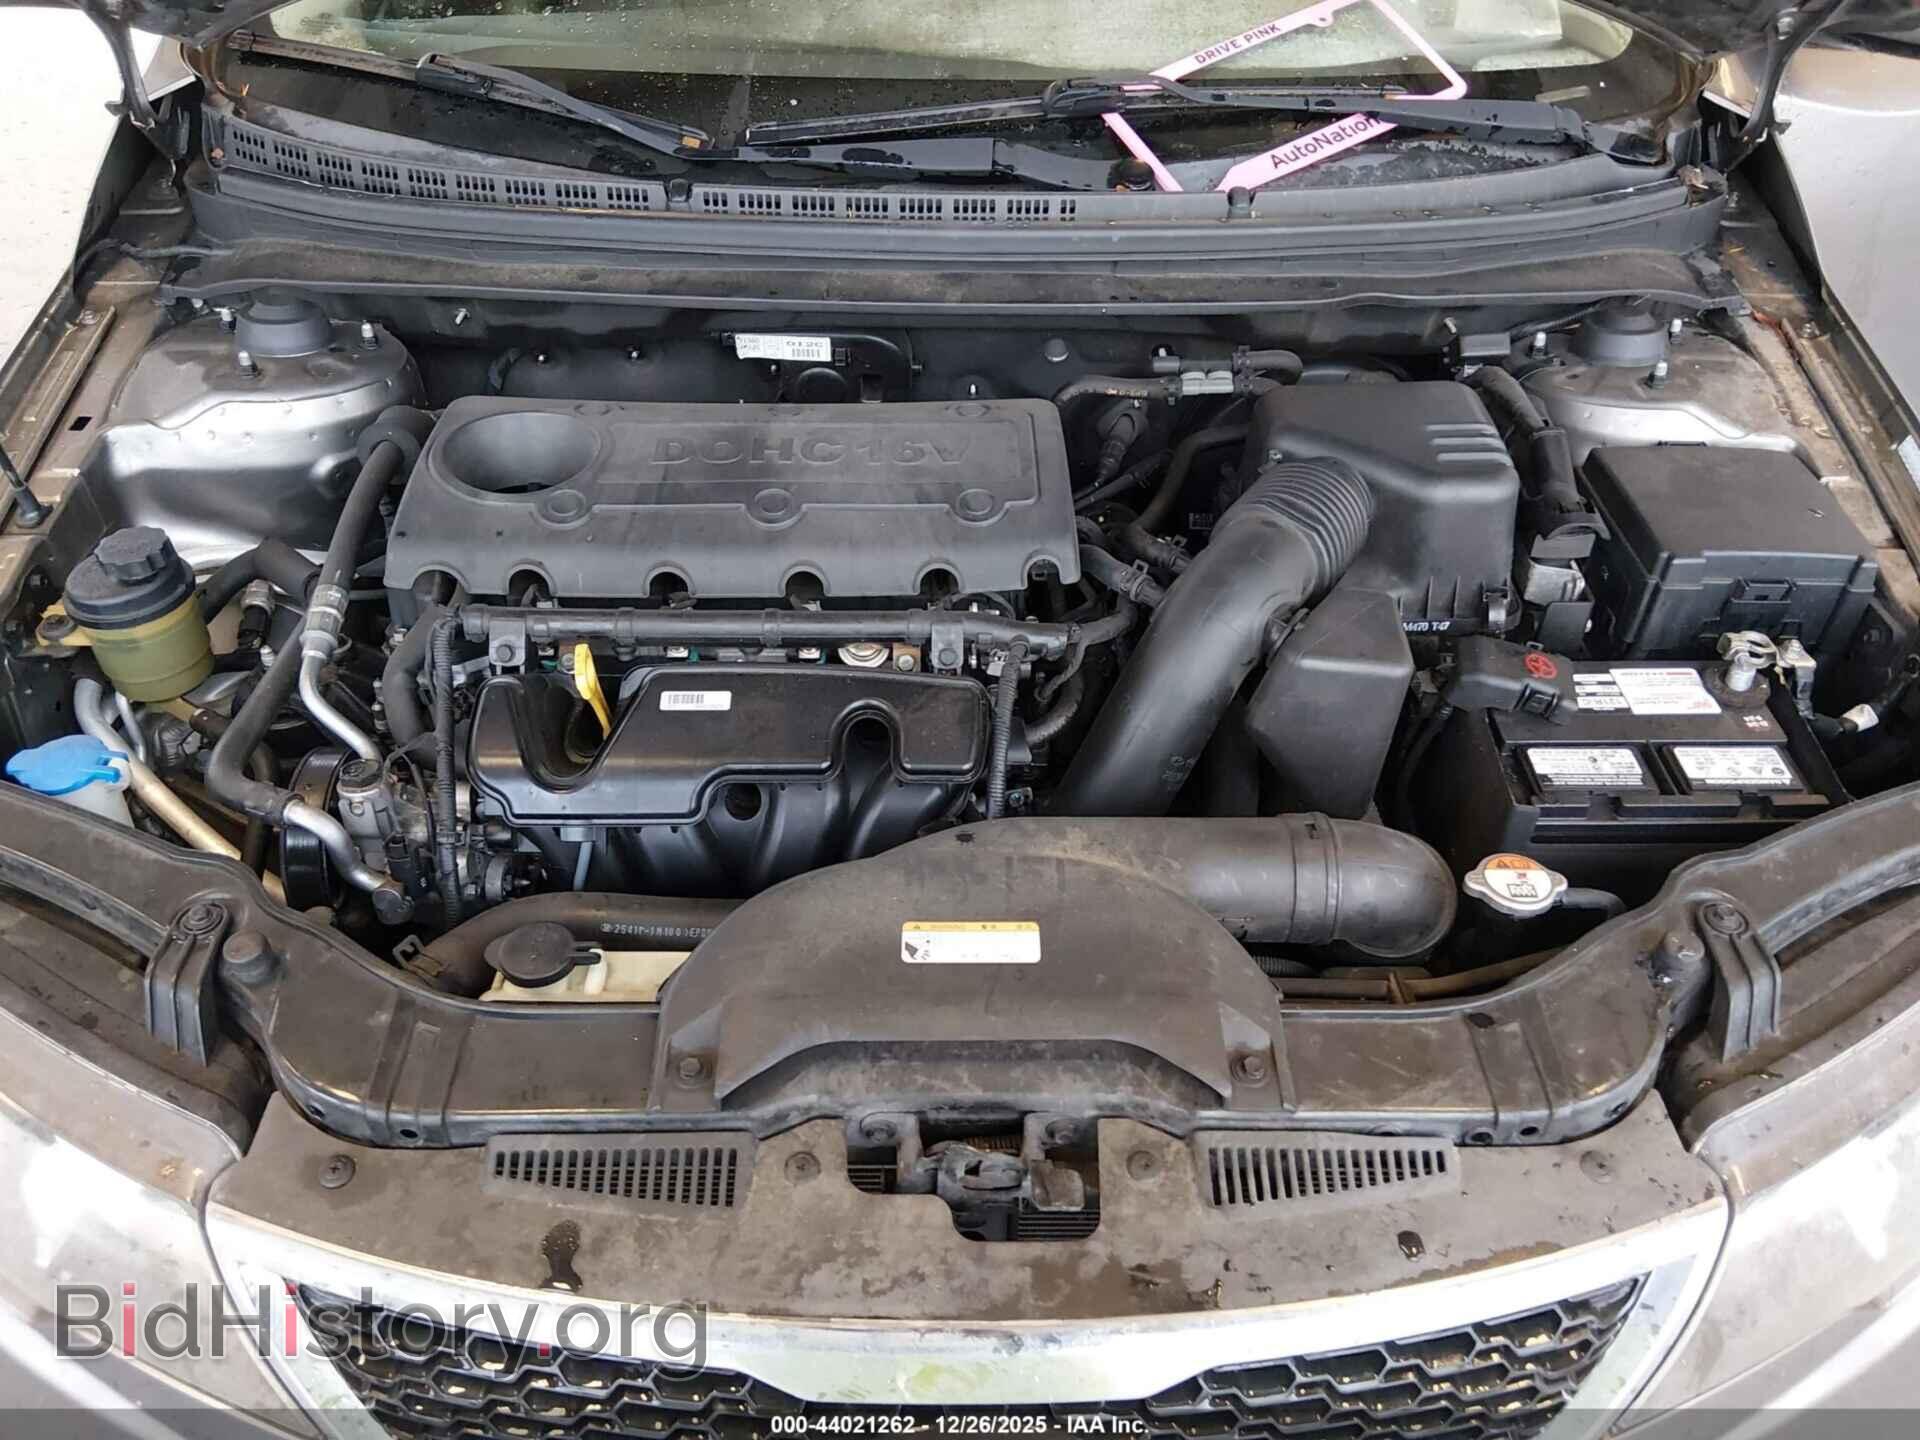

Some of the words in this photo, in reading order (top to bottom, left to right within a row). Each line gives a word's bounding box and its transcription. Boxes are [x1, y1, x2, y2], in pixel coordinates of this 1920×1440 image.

[1194, 39, 1242, 65] DRIVE
[1245, 23, 1281, 44] PINK
[1270, 114, 1381, 169] AutoNation
